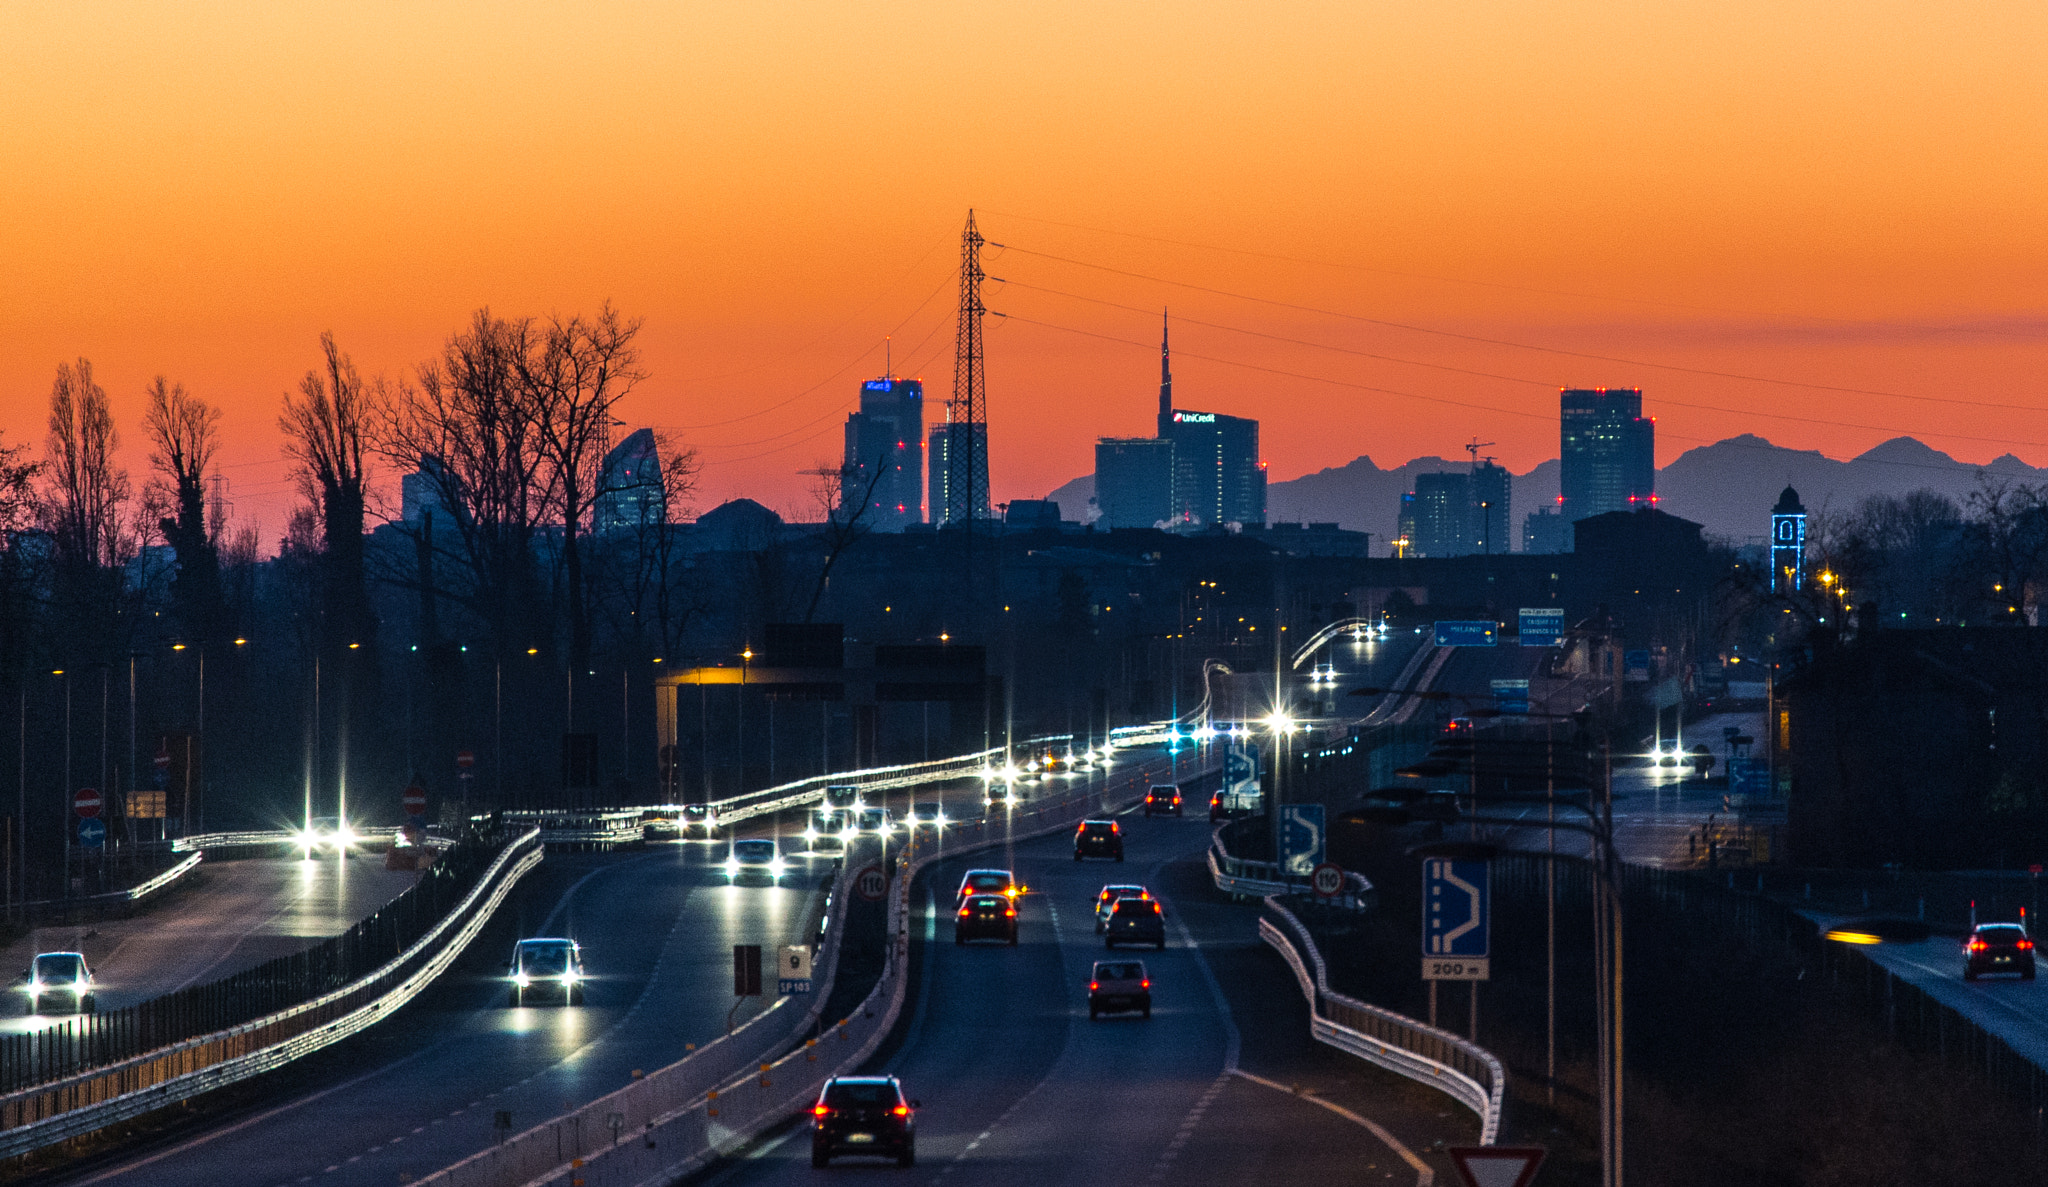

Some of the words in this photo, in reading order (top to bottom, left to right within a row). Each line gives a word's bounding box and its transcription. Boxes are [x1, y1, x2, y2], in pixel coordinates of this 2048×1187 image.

[1182, 413, 1215, 422] UniCredit
[863, 877, 883, 892] 110
[1319, 873, 1338, 888] 110
[790, 955, 800, 969] 9
[1432, 964, 1463, 975] 200
